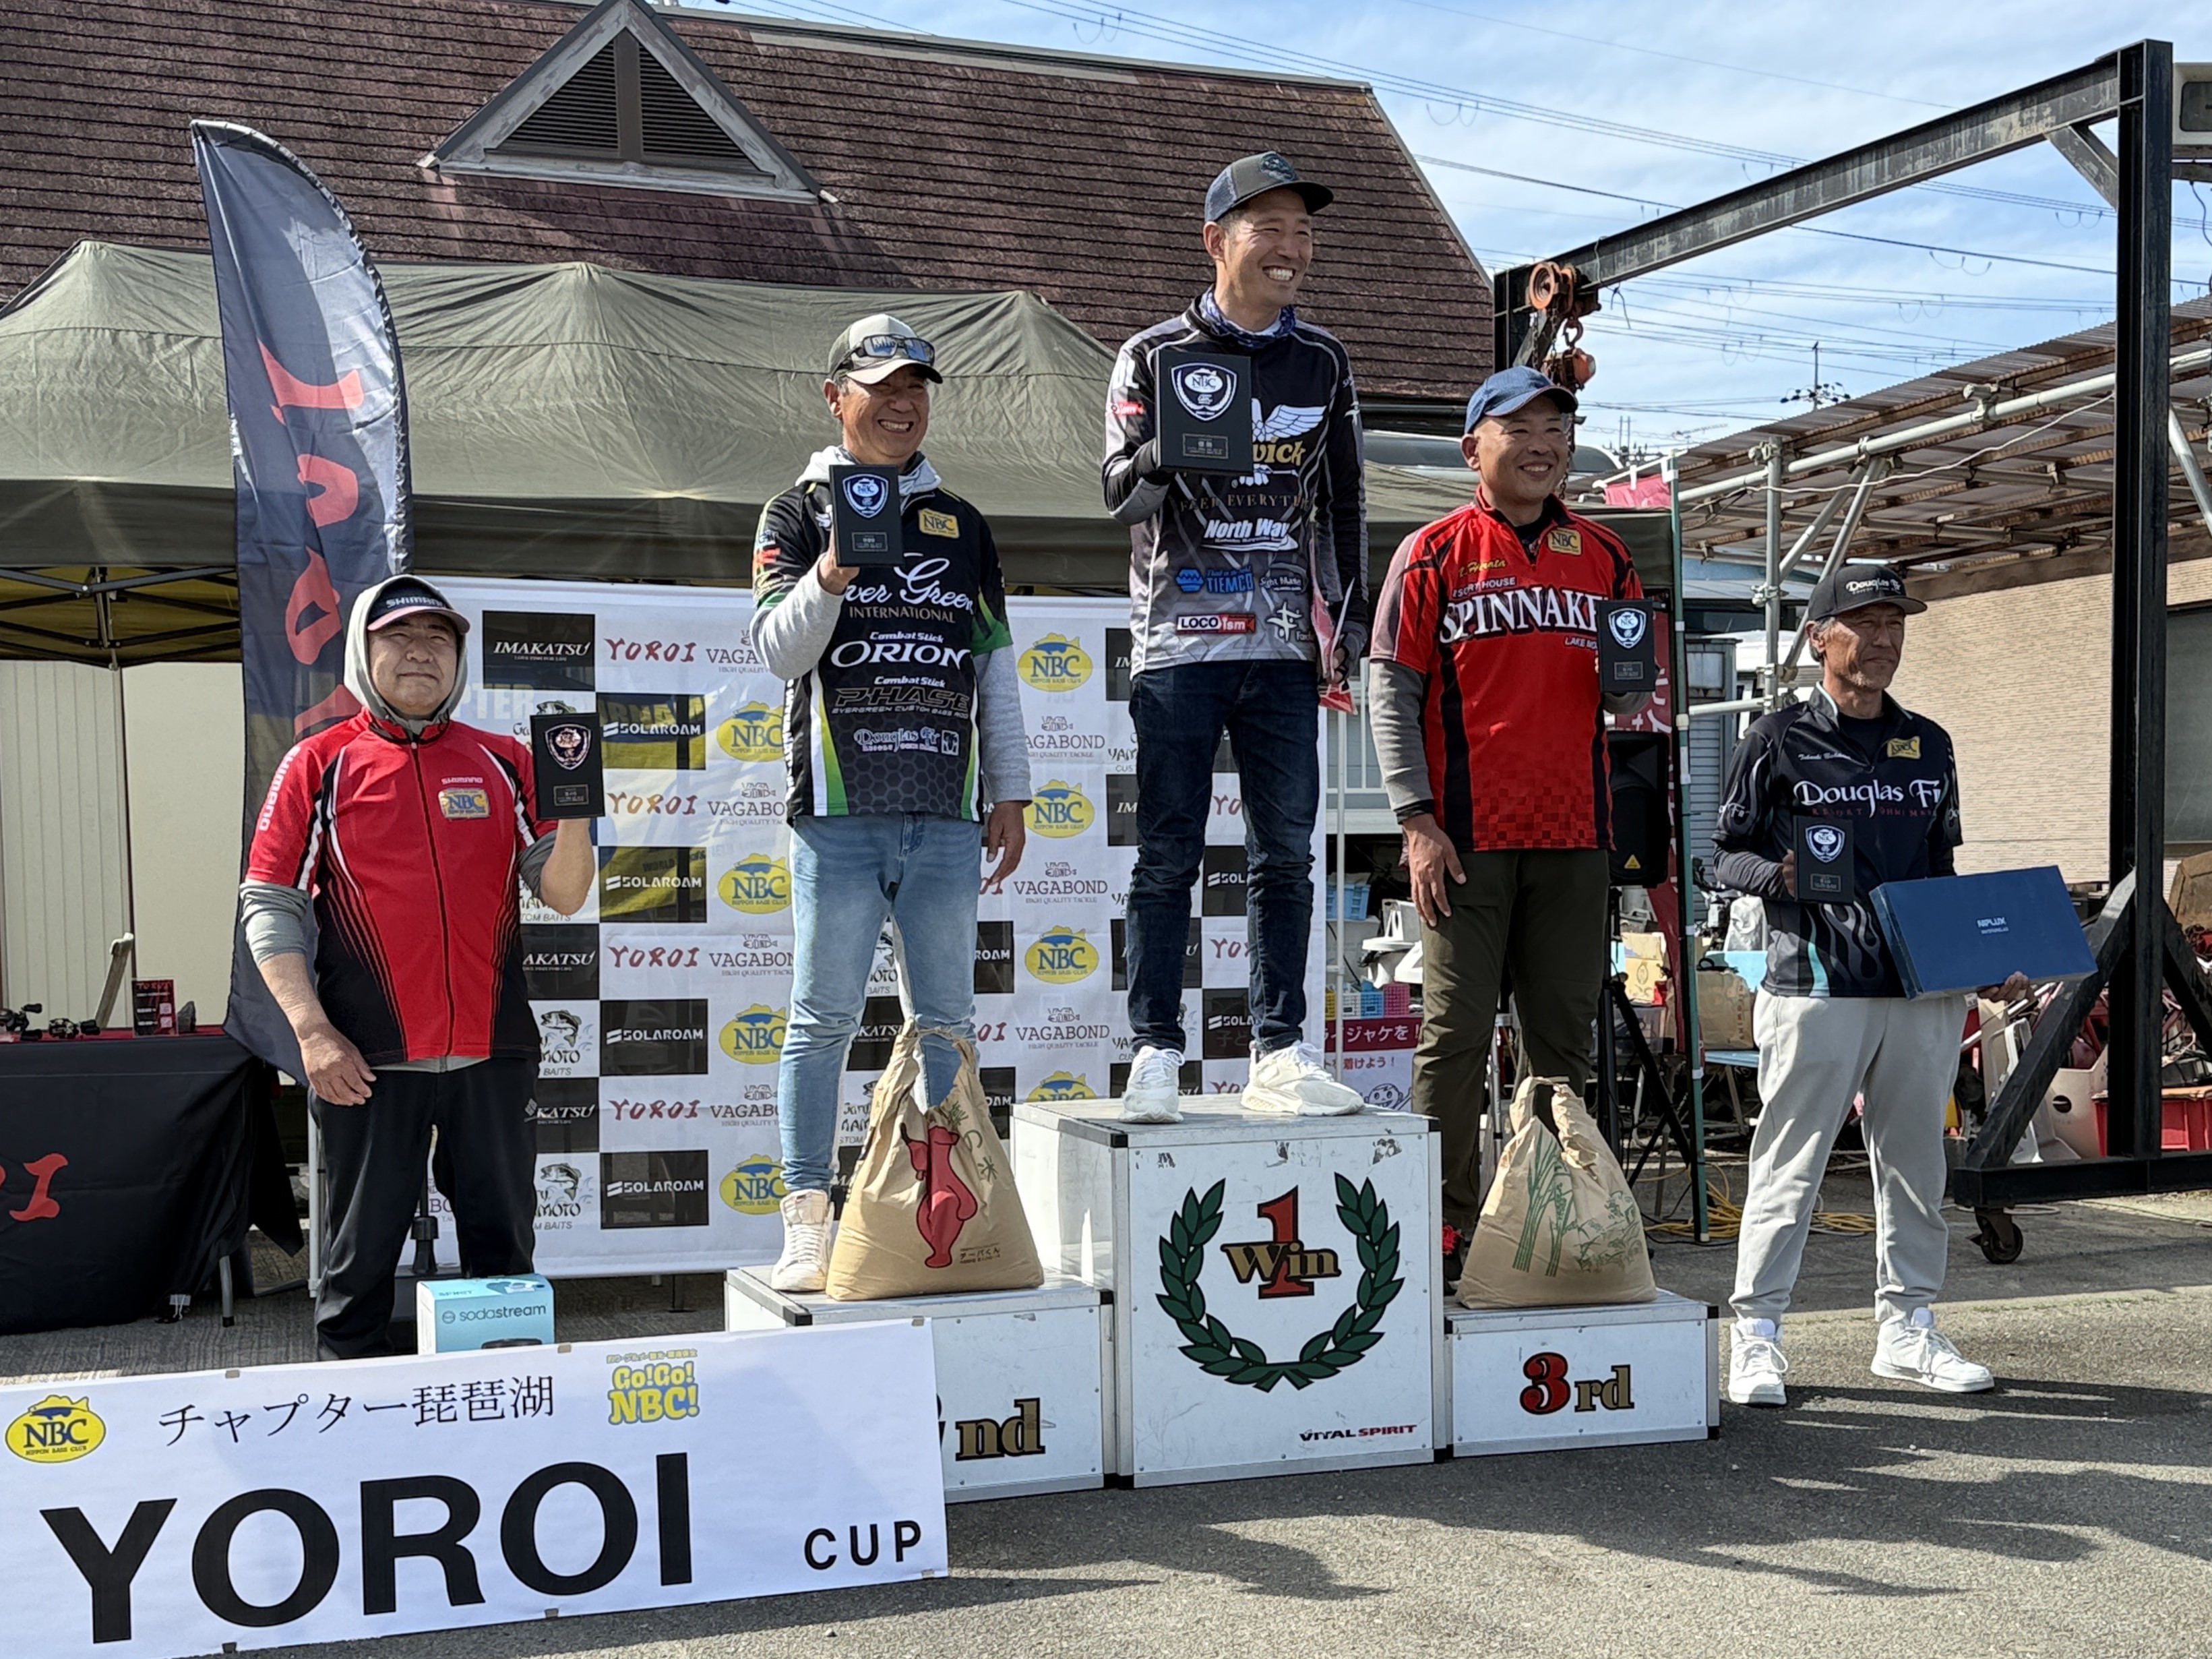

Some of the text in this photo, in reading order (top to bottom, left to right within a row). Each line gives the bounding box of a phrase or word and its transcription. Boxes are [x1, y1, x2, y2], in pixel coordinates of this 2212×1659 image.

[923, 514, 955, 531] NBC
[1204, 518, 1291, 539] North Way
[1552, 532, 1578, 549] NBC
[1207, 572, 1254, 593] TIEMCO
[1481, 576, 1516, 589] HOUSE
[849, 606, 956, 624] INTERNATIONAL
[1181, 617, 1219, 628] LOCO
[1439, 586, 1609, 644] SPINNAKE
[869, 631, 944, 643] Combat Stick
[493, 641, 591, 657] IMAKATSU
[603, 638, 697, 663] YOROI
[830, 640, 971, 669] ORION
[1030, 655, 1082, 678] NBC
[874, 675, 946, 688] Combat Stick
[836, 686, 971, 713] PHASE
[619, 722, 701, 735] SOLAROAM
[731, 725, 785, 748] NBC
[259, 745, 301, 832] SHIMANO
[1793, 779, 1905, 819] Douglas
[448, 794, 486, 812] NBC
[606, 791, 698, 816] YOROI
[708, 801, 785, 817] VAGABO
[1033, 802, 1084, 824] NBC
[621, 876, 702, 888] SOLAROAM
[731, 876, 787, 900] NBC
[1013, 880, 1108, 895] VAGABOND
[609, 946, 700, 969] YOROI
[1037, 946, 1088, 970] NBC
[623, 1029, 704, 1042] SOLAROAM
[733, 1026, 786, 1050] NBC
[1015, 1024, 1111, 1042] VAGABOND
[543, 1067, 572, 1077] BAITS
[536, 1104, 596, 1118] KATSU
[609, 1098, 702, 1120] YOROI
[623, 1180, 704, 1193] SOLAROAM
[733, 1176, 788, 1201] NBC
[544, 1221, 573, 1230] BAITS
[1258, 1184, 1315, 1300] 1
[1220, 1240, 1341, 1284] Win
[459, 1304, 547, 1322] sodastream
[612, 1361, 695, 1391] Go!Go!
[1520, 1351, 1634, 1415] 3rd
[158, 1375, 553, 1447] チャプター琵琶湖
[608, 1383, 700, 1426] NBC!
[23, 1418, 90, 1448] NBC
[936, 1393, 1046, 1461] nd
[1299, 1424, 1418, 1442] VITAL SPIRIT
[39, 1452, 692, 1644] YOROI
[803, 1520, 921, 1571] CUP
